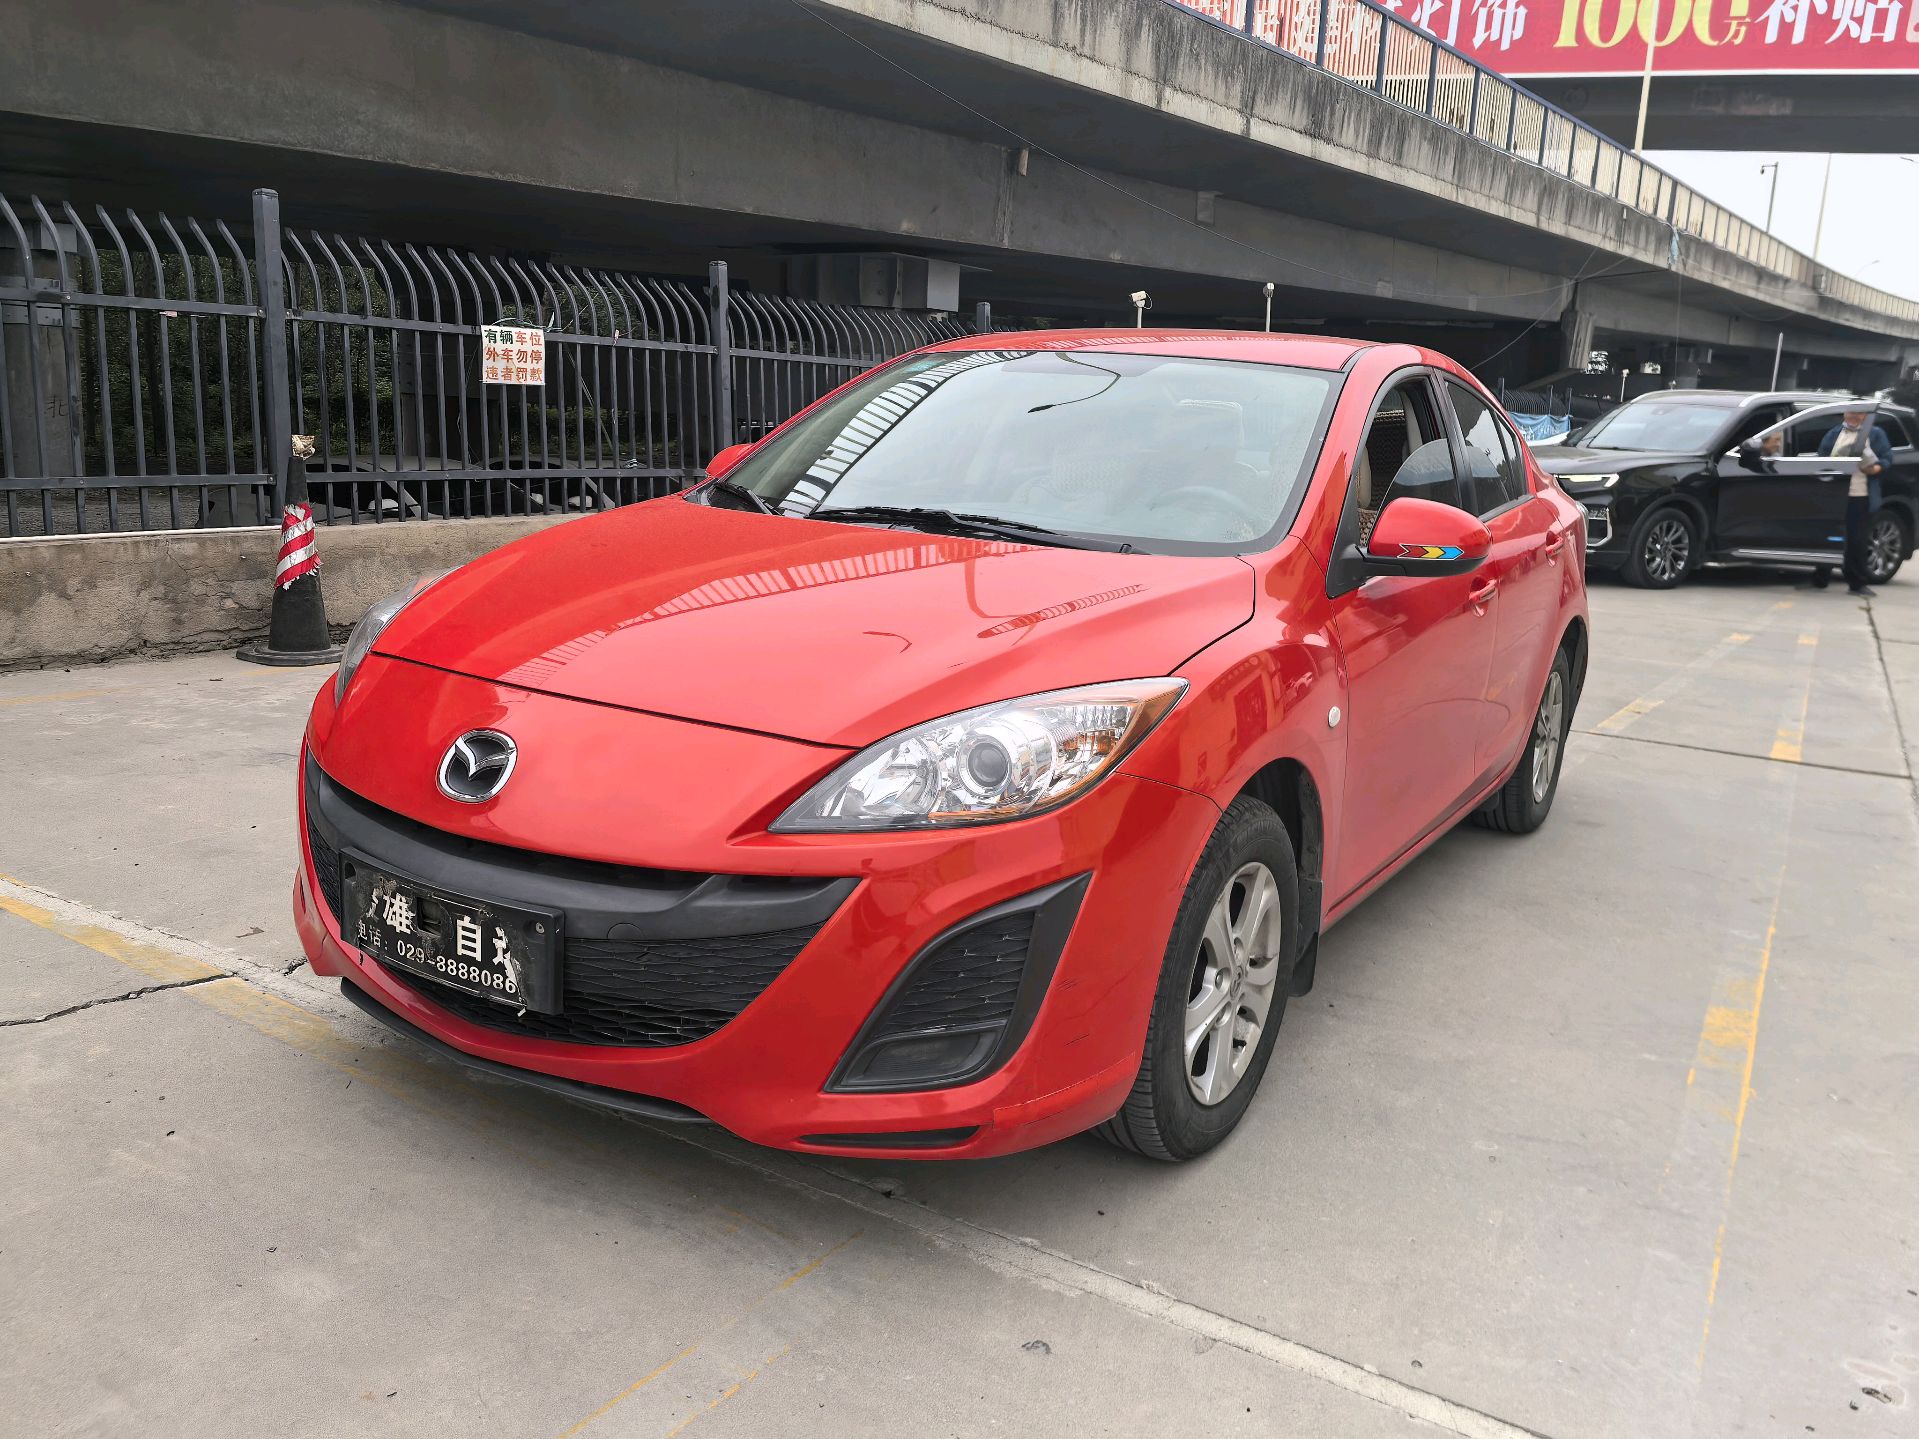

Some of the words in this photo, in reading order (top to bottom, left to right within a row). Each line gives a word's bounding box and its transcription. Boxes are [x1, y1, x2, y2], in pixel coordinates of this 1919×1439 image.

[484, 328, 543, 347] 有辆车位
[485, 346, 543, 364] 外车勿停
[485, 365, 543, 382] 违者罚款
